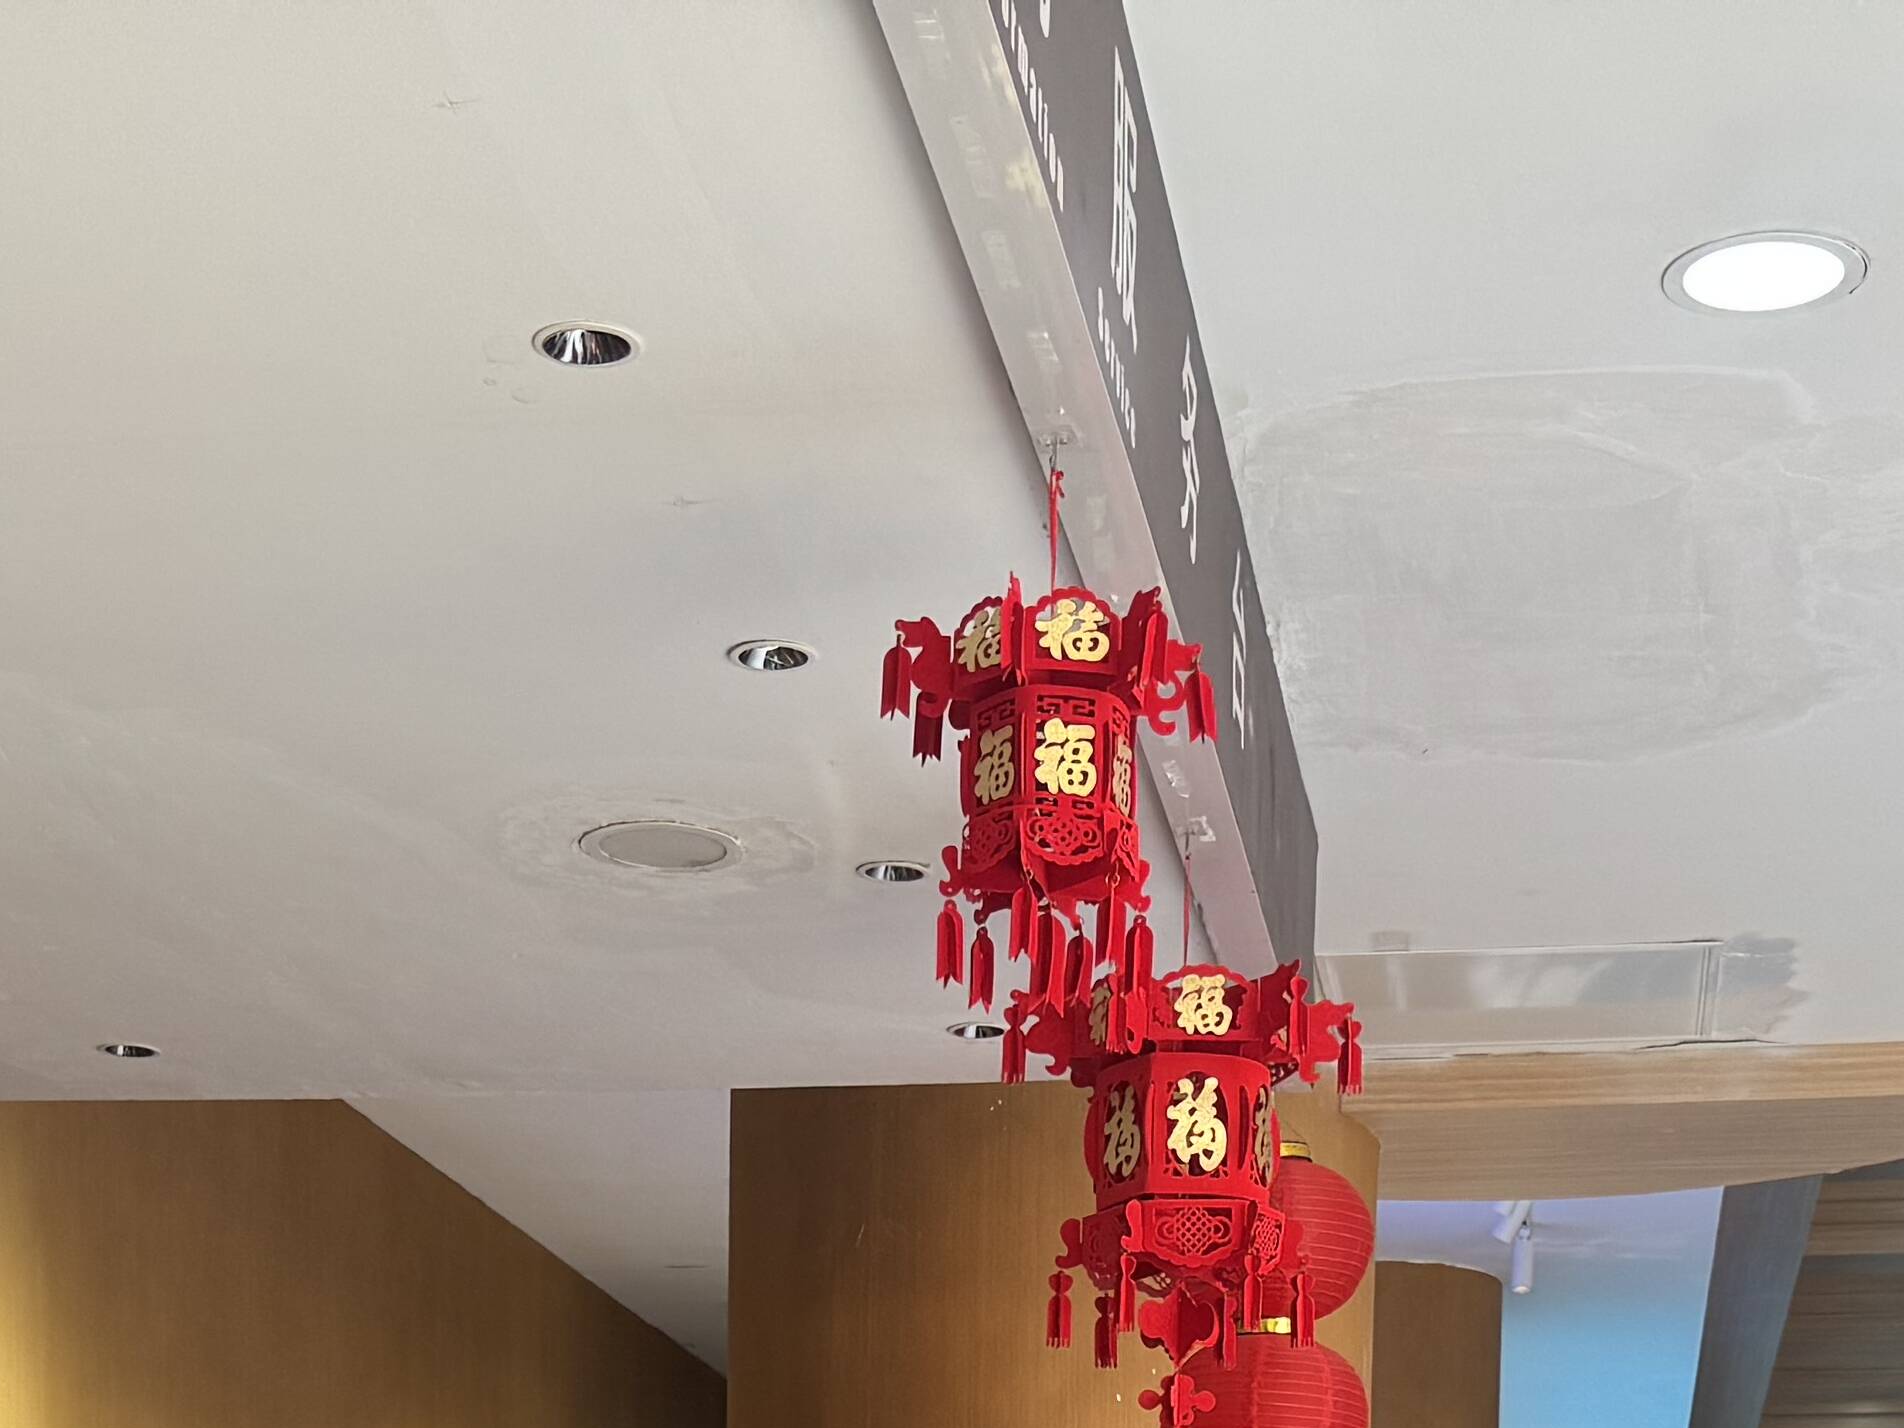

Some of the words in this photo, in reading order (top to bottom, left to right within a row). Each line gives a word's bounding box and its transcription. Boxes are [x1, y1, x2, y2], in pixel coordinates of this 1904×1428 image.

[1035, 599, 1111, 662] 福
[974, 724, 1015, 805] 福
[1034, 717, 1097, 797] 福
[1174, 974, 1233, 1036] 福
[1103, 1084, 1141, 1177] 福
[1167, 1077, 1228, 1172] 福
